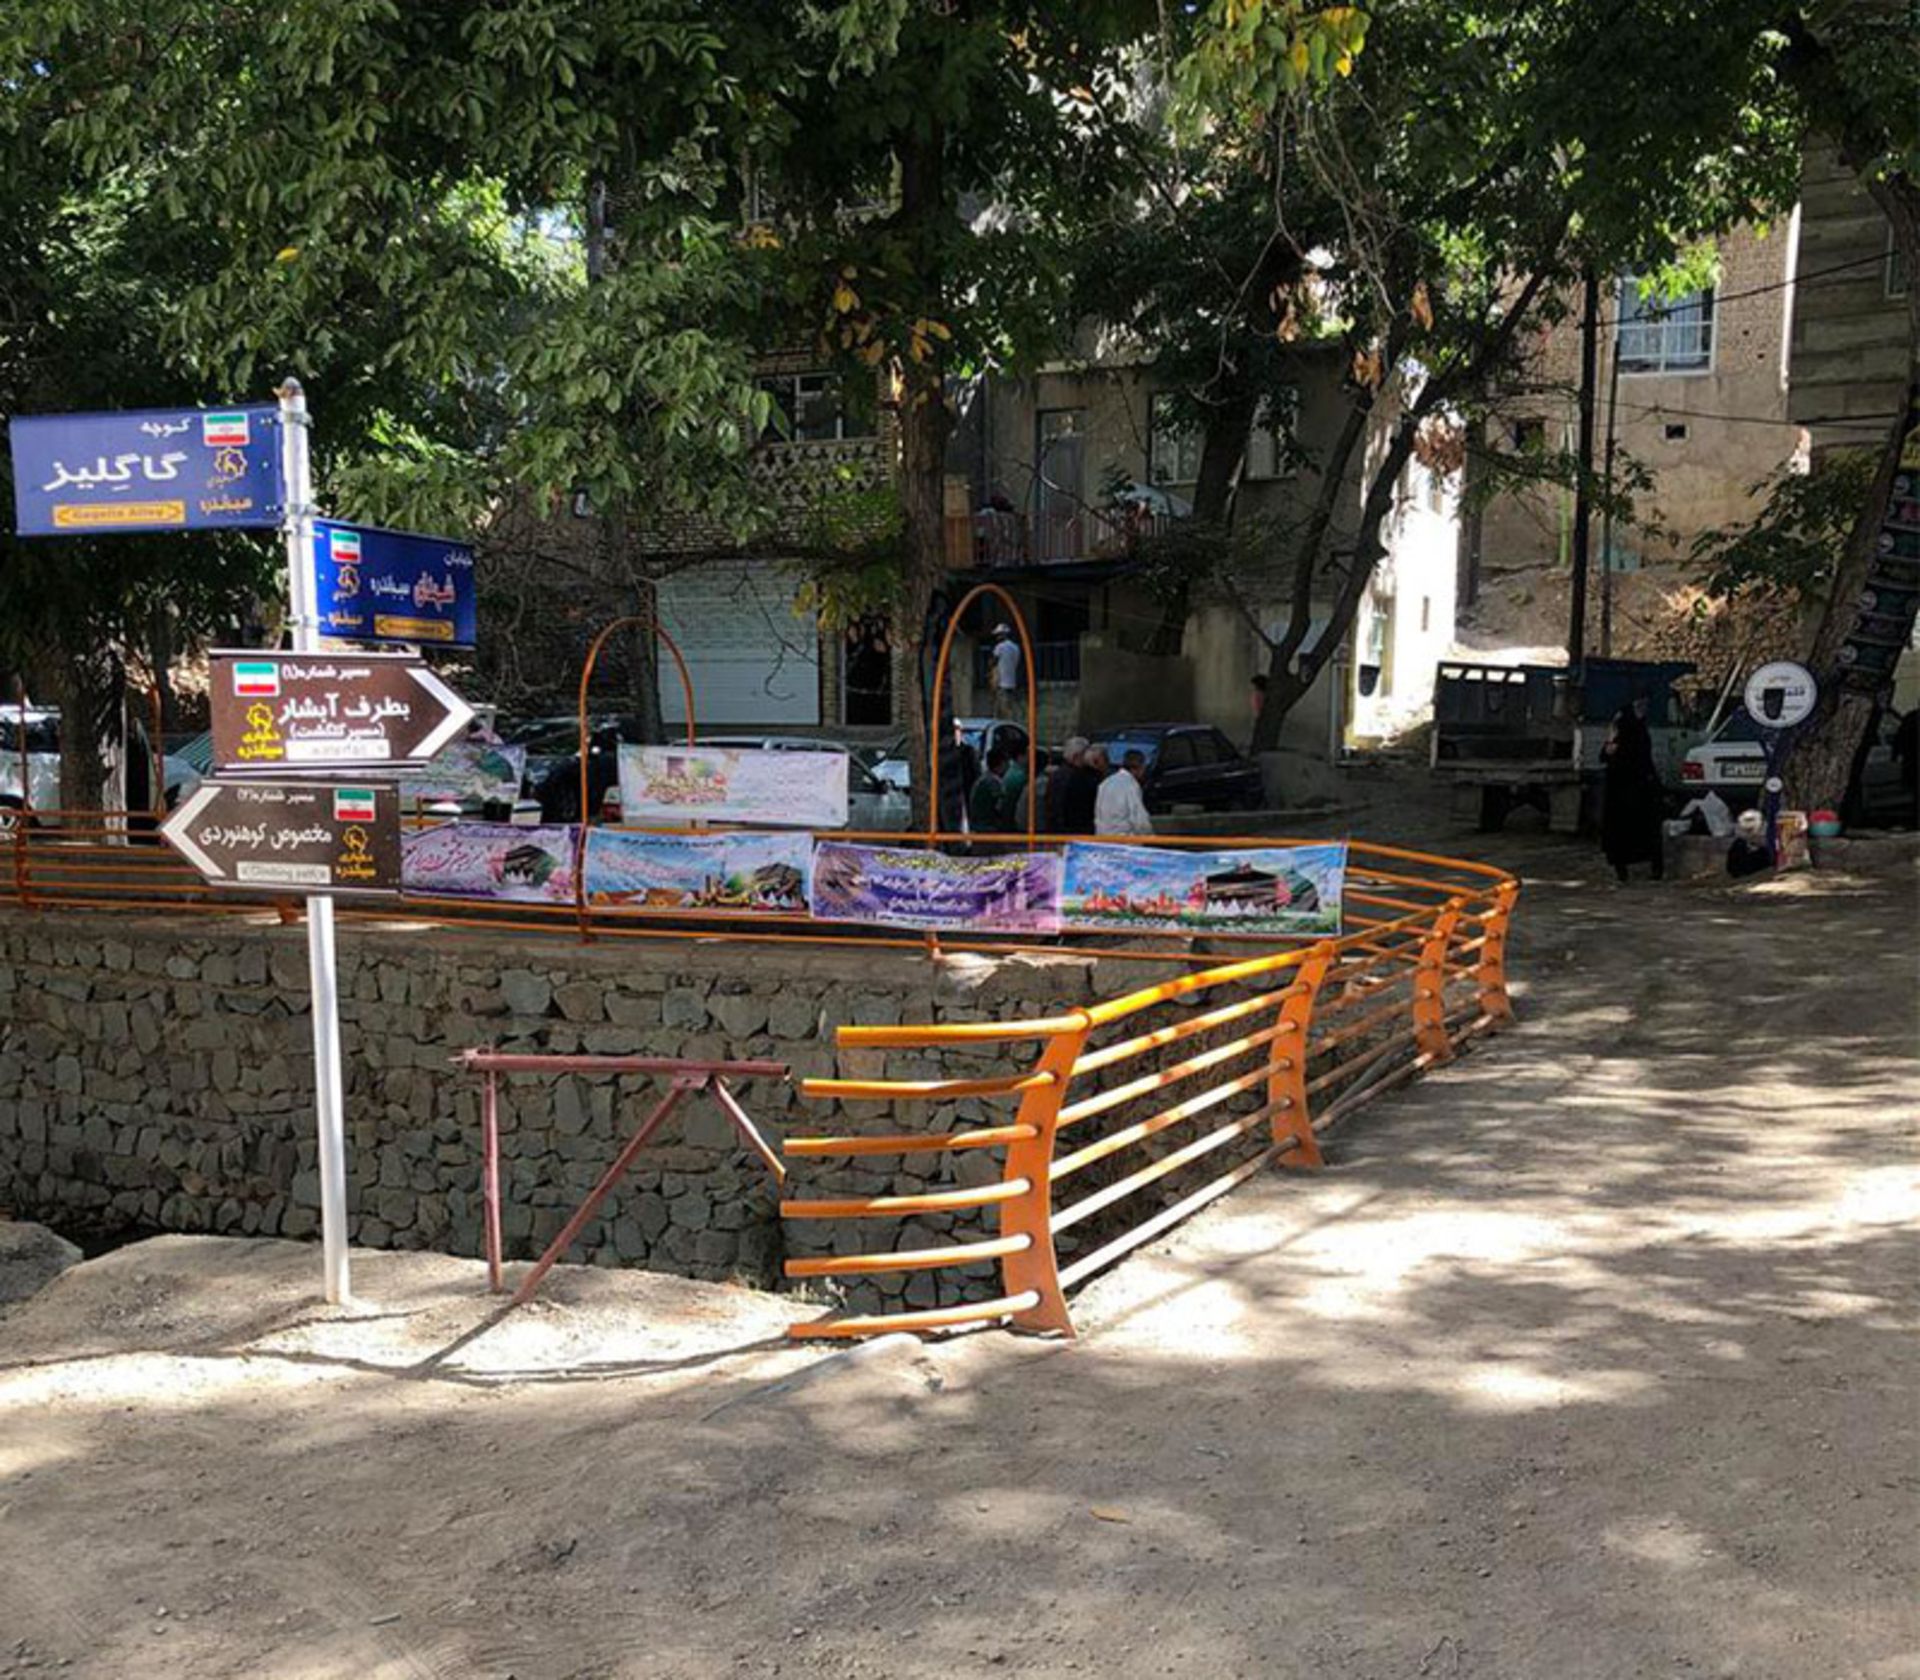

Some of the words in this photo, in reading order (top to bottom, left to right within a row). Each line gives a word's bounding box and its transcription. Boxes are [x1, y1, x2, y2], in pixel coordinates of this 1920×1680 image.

[140, 417, 191, 437] کوچه
[337, 668, 371, 681] مسیر
[278, 692, 340, 725] آبشار
[344, 694, 411, 723] بطرف
[286, 794, 316, 805] مسیر
[199, 822, 268, 850] کوهنوردی
[270, 822, 333, 850] مخصوص
